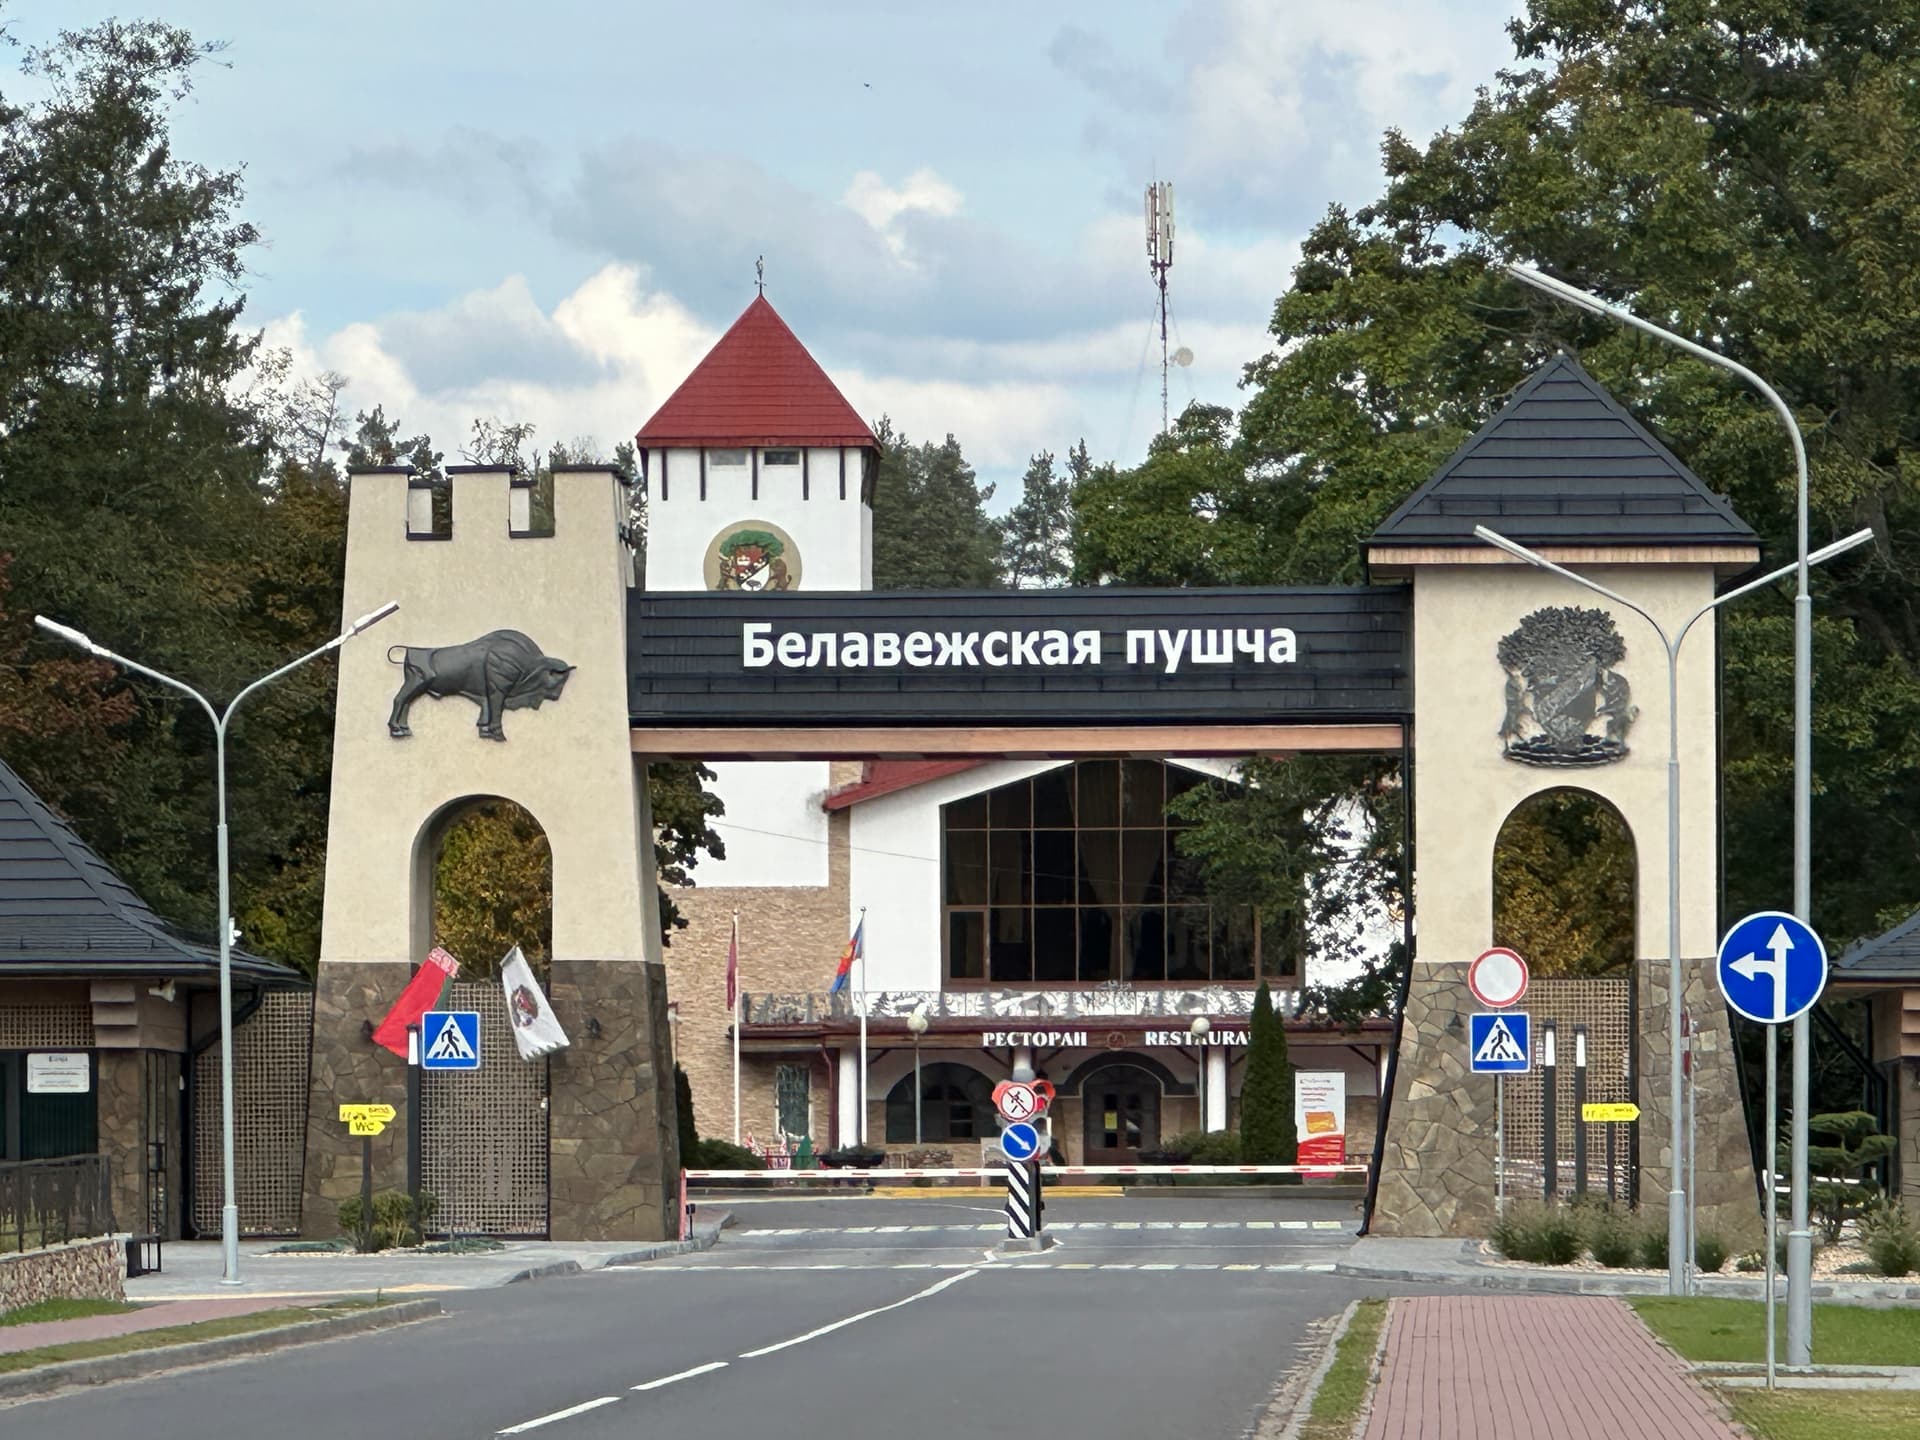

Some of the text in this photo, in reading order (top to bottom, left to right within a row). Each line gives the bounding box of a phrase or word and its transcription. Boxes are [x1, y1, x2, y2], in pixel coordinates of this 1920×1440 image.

[742, 621, 1299, 674] Белавежская пушча
[982, 1031, 1088, 1046] РЕСТОРАН
[1144, 1030, 1252, 1046] RESTAURA
[355, 1121, 375, 1132] WC
